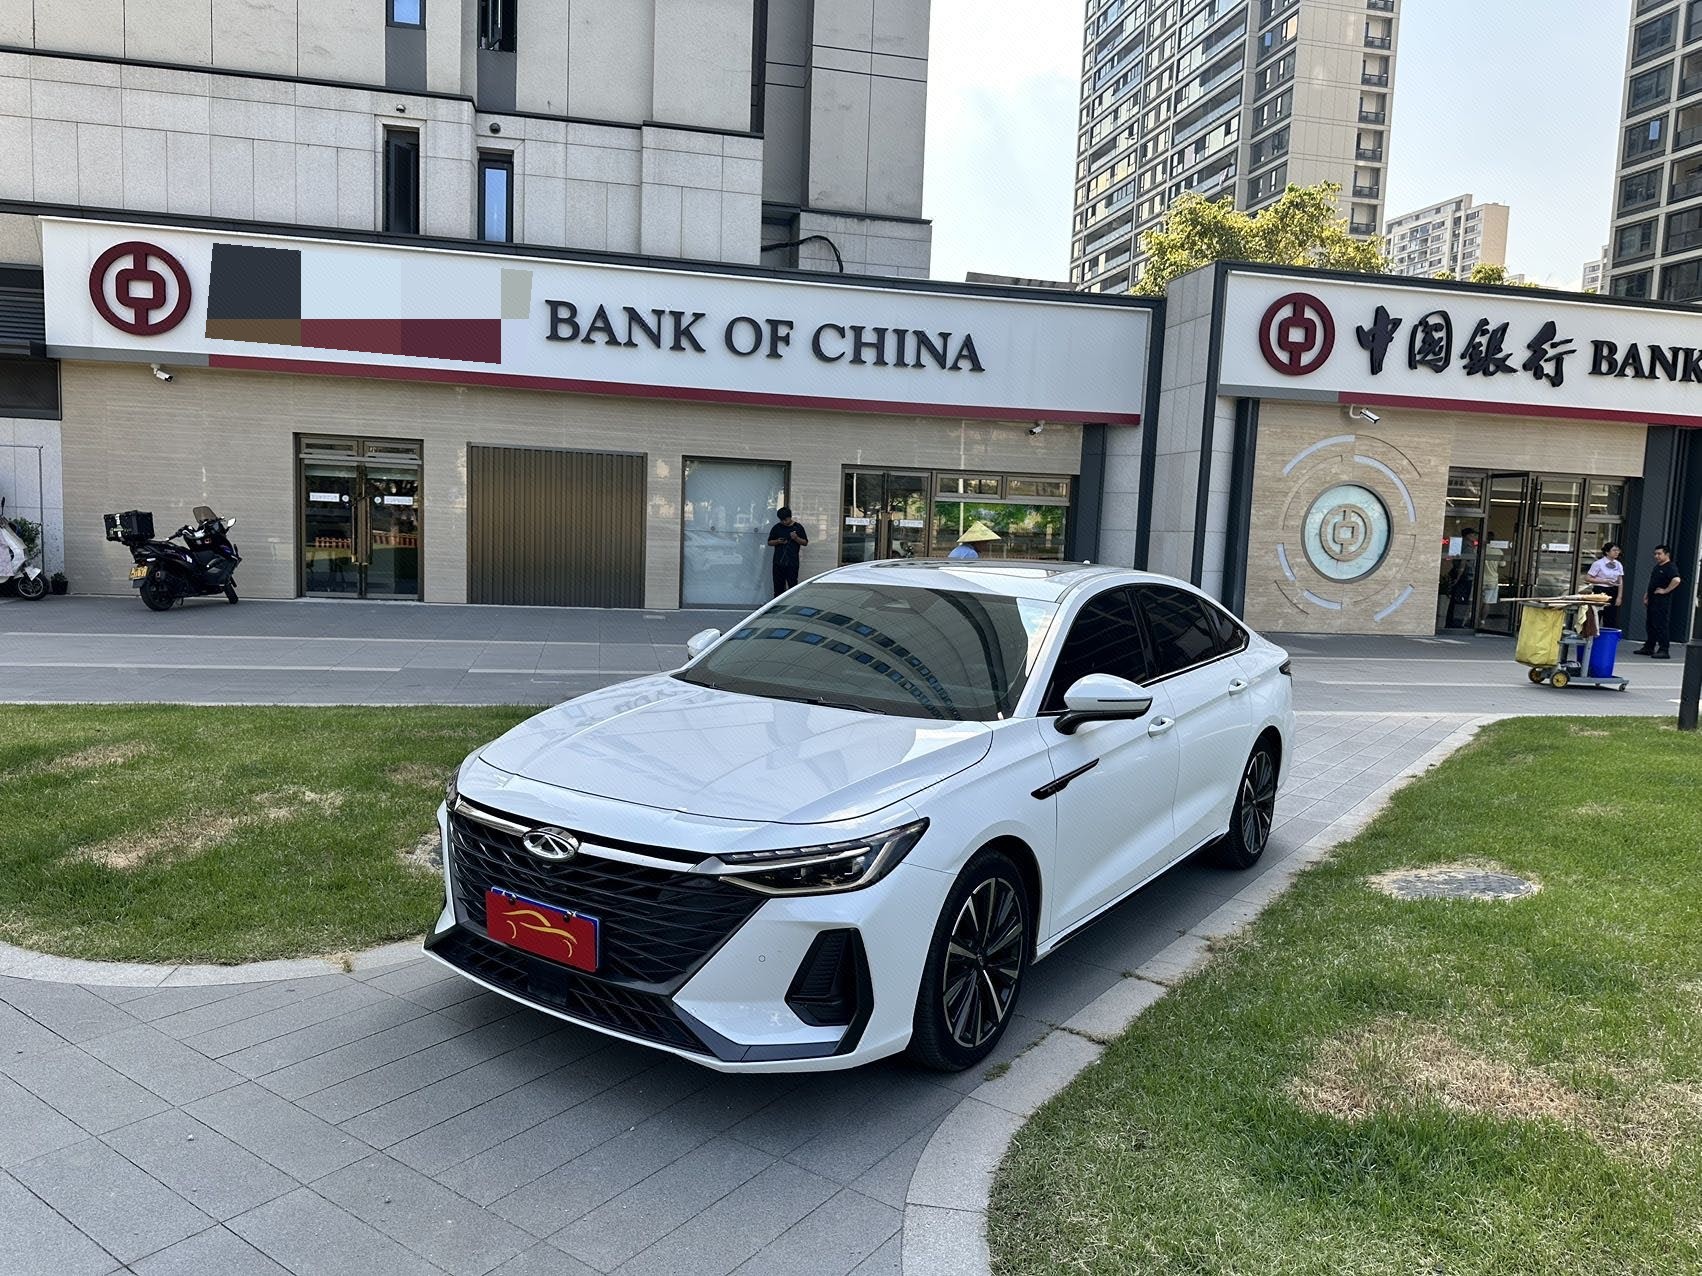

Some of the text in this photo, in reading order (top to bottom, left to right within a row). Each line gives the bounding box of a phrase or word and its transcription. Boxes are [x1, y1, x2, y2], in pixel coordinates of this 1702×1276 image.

[545, 299, 986, 372] BANK OF CHINA
